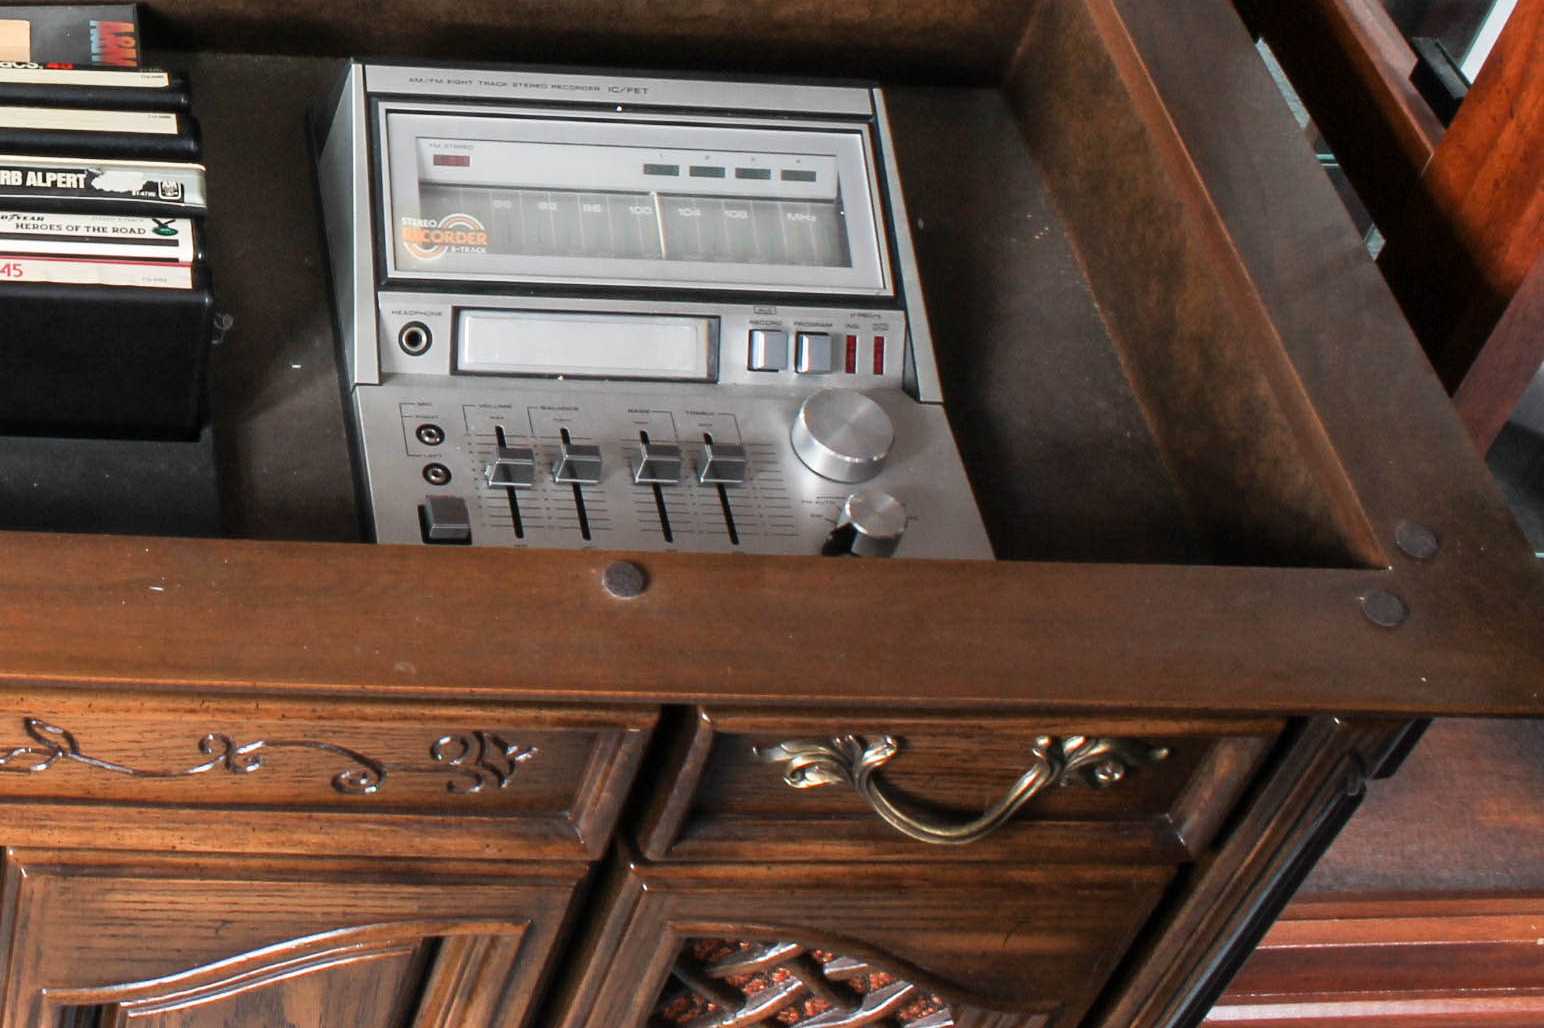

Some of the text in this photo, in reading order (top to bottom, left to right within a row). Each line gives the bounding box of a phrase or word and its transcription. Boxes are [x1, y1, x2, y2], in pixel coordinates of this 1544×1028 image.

[478, 80, 509, 88] TRACK
[512, 82, 549, 90] STEREO
[550, 84, 601, 92] RECORDER
[607, 86, 649, 95] IC/FET
[25, 171, 88, 190] ALPERT
[15, 222, 147, 235] HEROES OF THE ROAD
[400, 216, 438, 229] STEREO
[401, 227, 489, 246] RECORDER
[0, 262, 24, 278] 45
